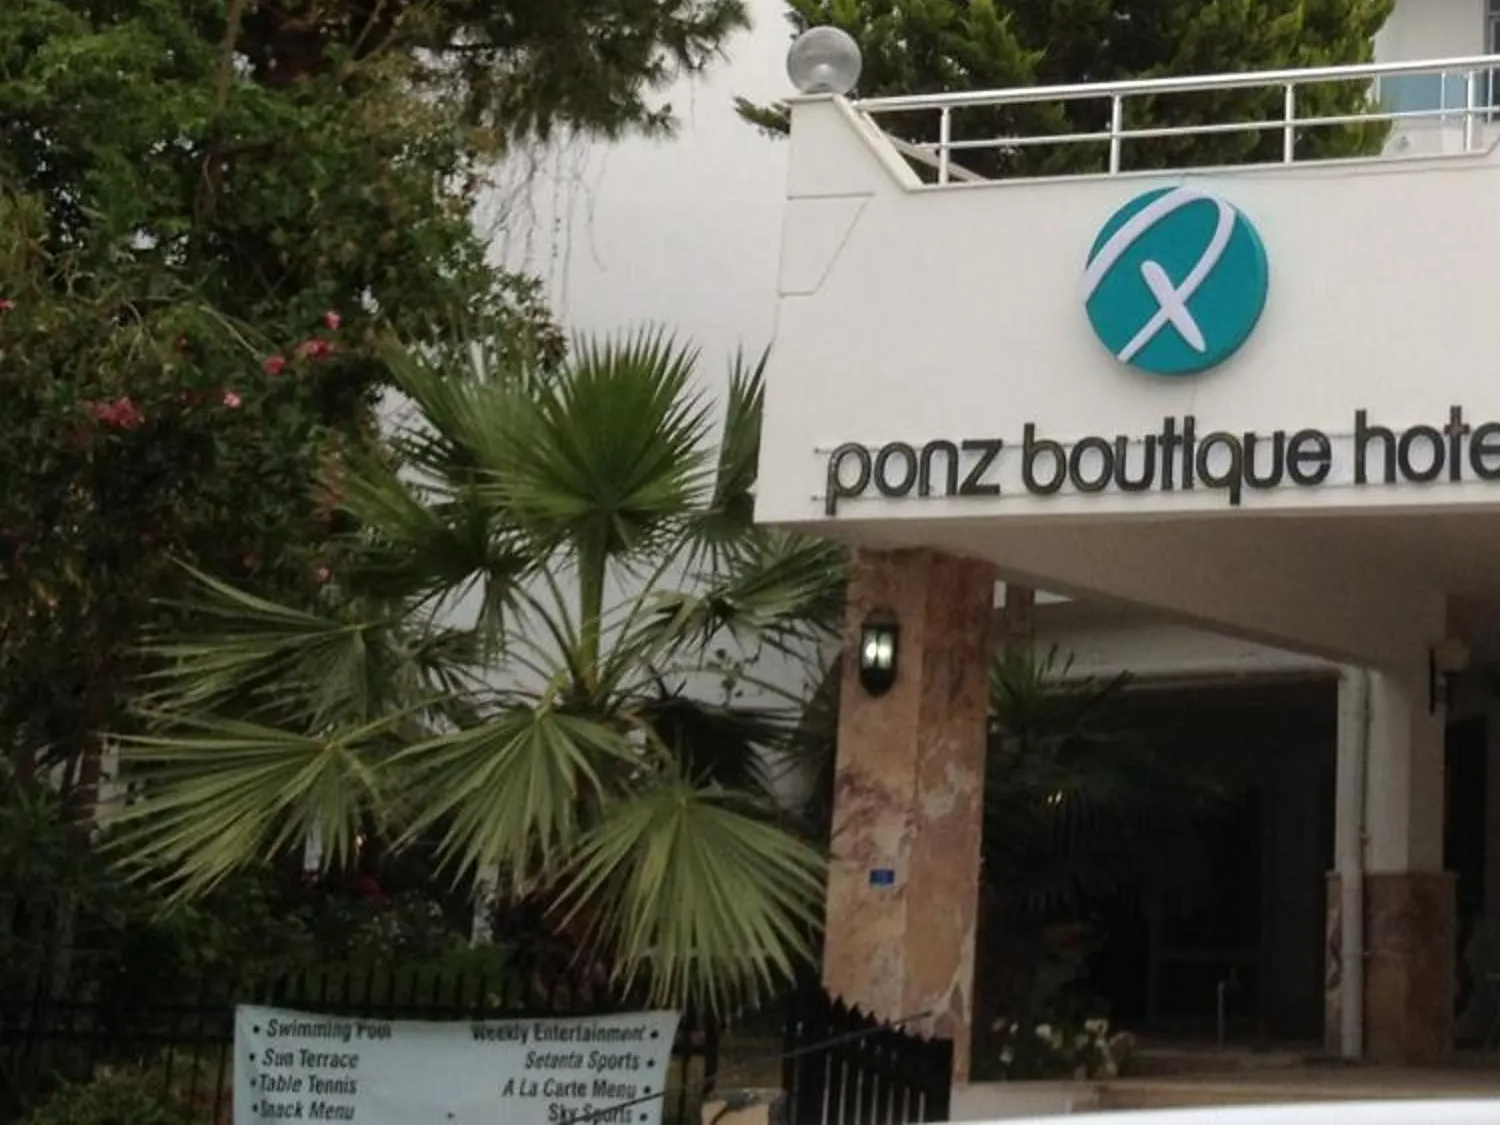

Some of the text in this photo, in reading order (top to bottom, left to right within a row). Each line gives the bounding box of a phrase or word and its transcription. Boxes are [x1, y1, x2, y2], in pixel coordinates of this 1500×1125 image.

[826, 438, 1003, 515] ponz
[1021, 415, 1332, 506] boutique
[266, 1018, 352, 1043] Swimming
[471, 1022, 647, 1045] Weekly Entertainment
[262, 1048, 360, 1069] Sun Terrace
[524, 1050, 640, 1073] Setanta Sports
[259, 1073, 358, 1095] Table Tennis
[502, 1077, 637, 1100] A La Carte Menu
[259, 1099, 355, 1121] Snack Menu
